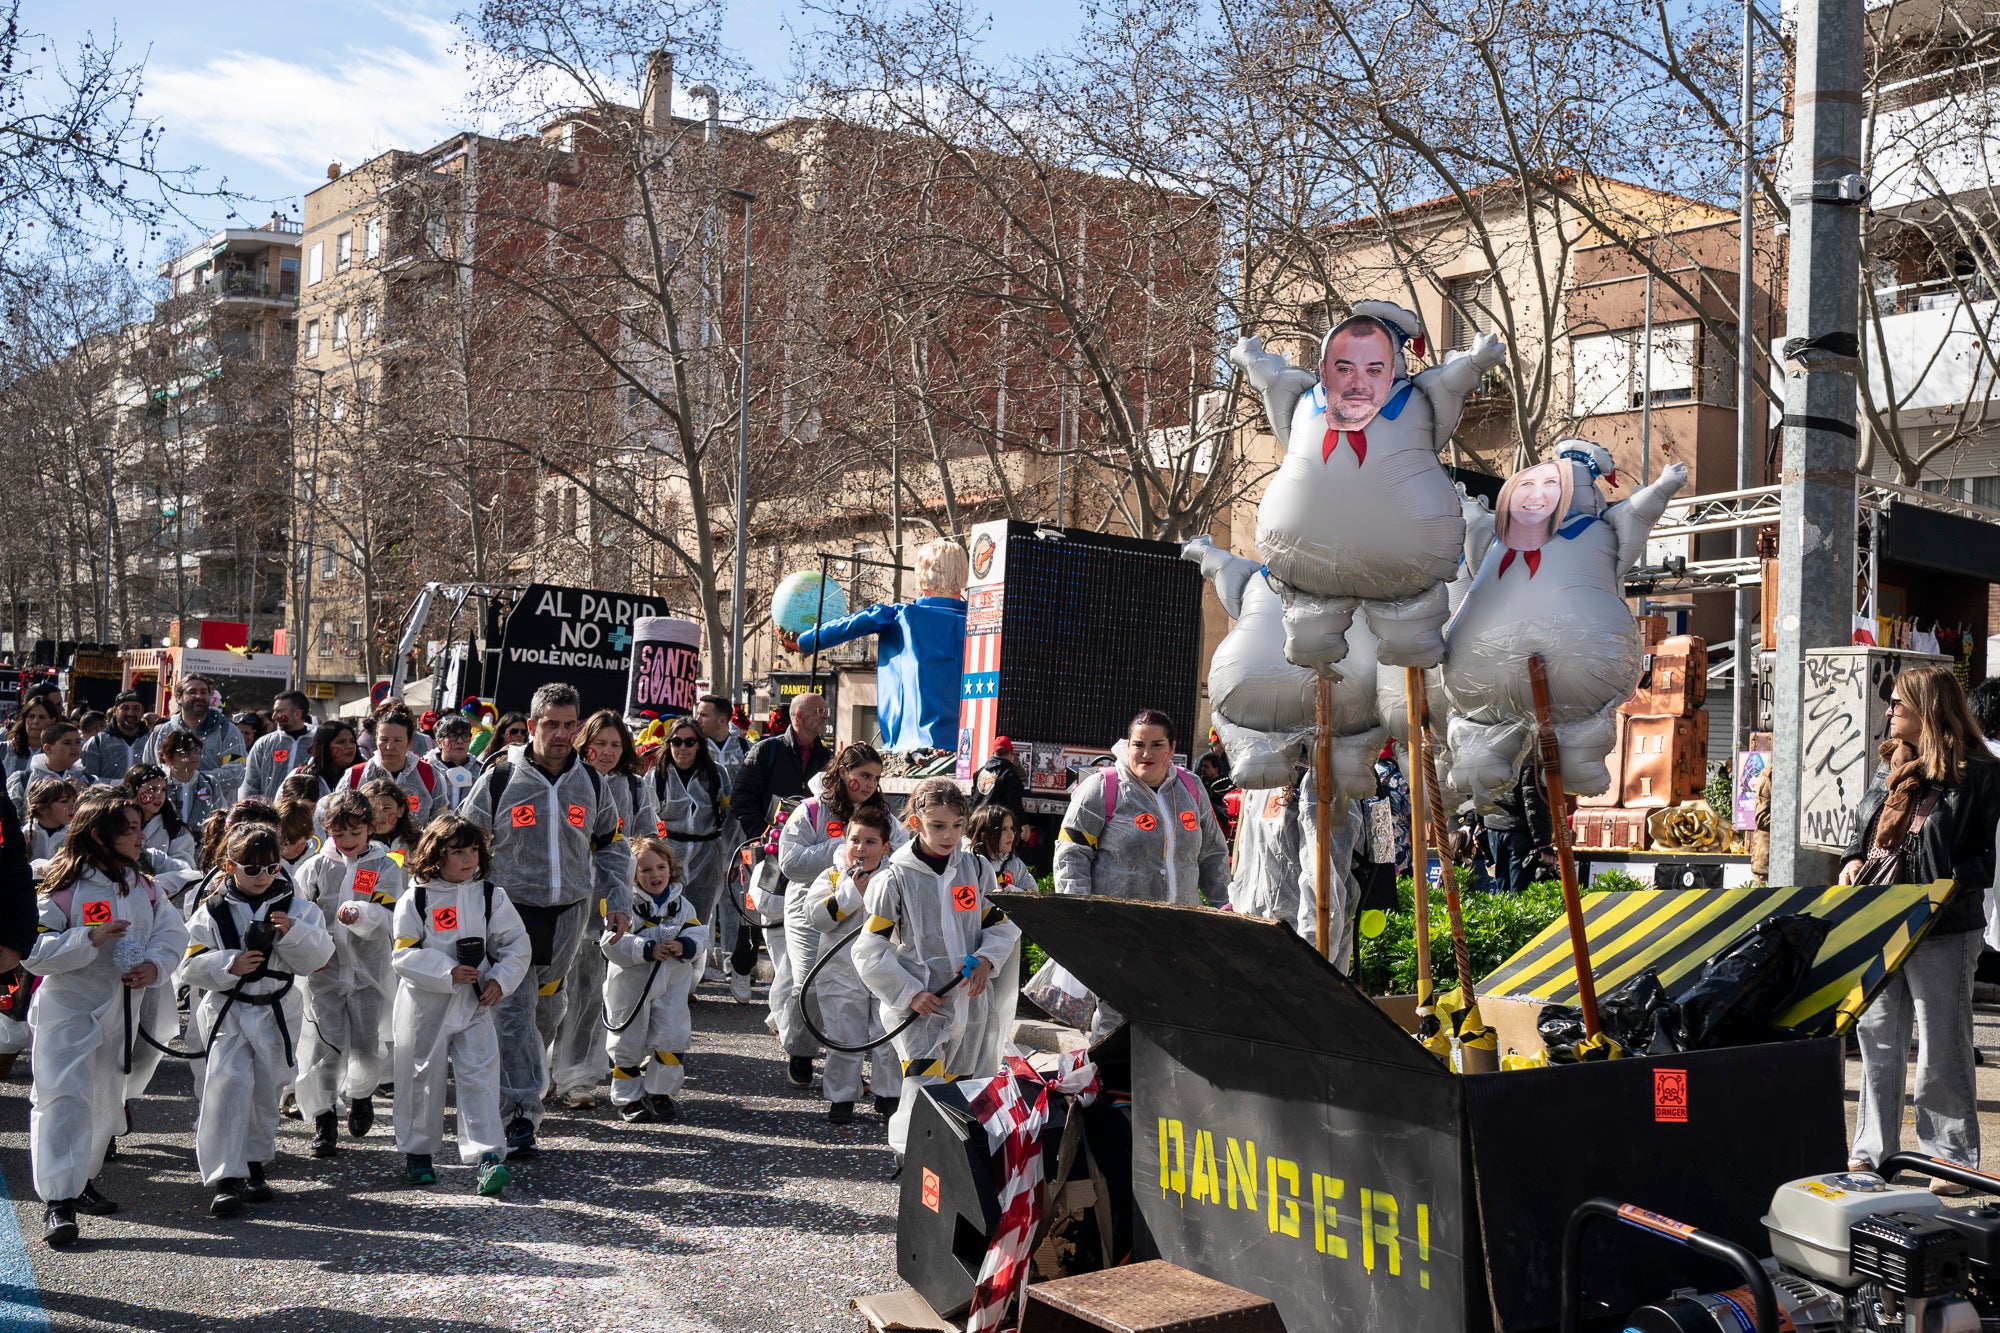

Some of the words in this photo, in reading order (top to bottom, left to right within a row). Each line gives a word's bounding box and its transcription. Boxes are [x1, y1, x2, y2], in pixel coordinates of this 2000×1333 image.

[535, 590, 572, 618] AL
[560, 621, 600, 649] NO
[510, 645, 604, 669] VIOLÈNCIA
[605, 659, 619, 670] NI
[639, 645, 698, 681] SANTS
[637, 674, 696, 711] OVARIS
[780, 684, 823, 696] FRANKFUT'S
[1656, 1107, 1687, 1117] DANGER
[1158, 1117, 1430, 1290] DANGER!
